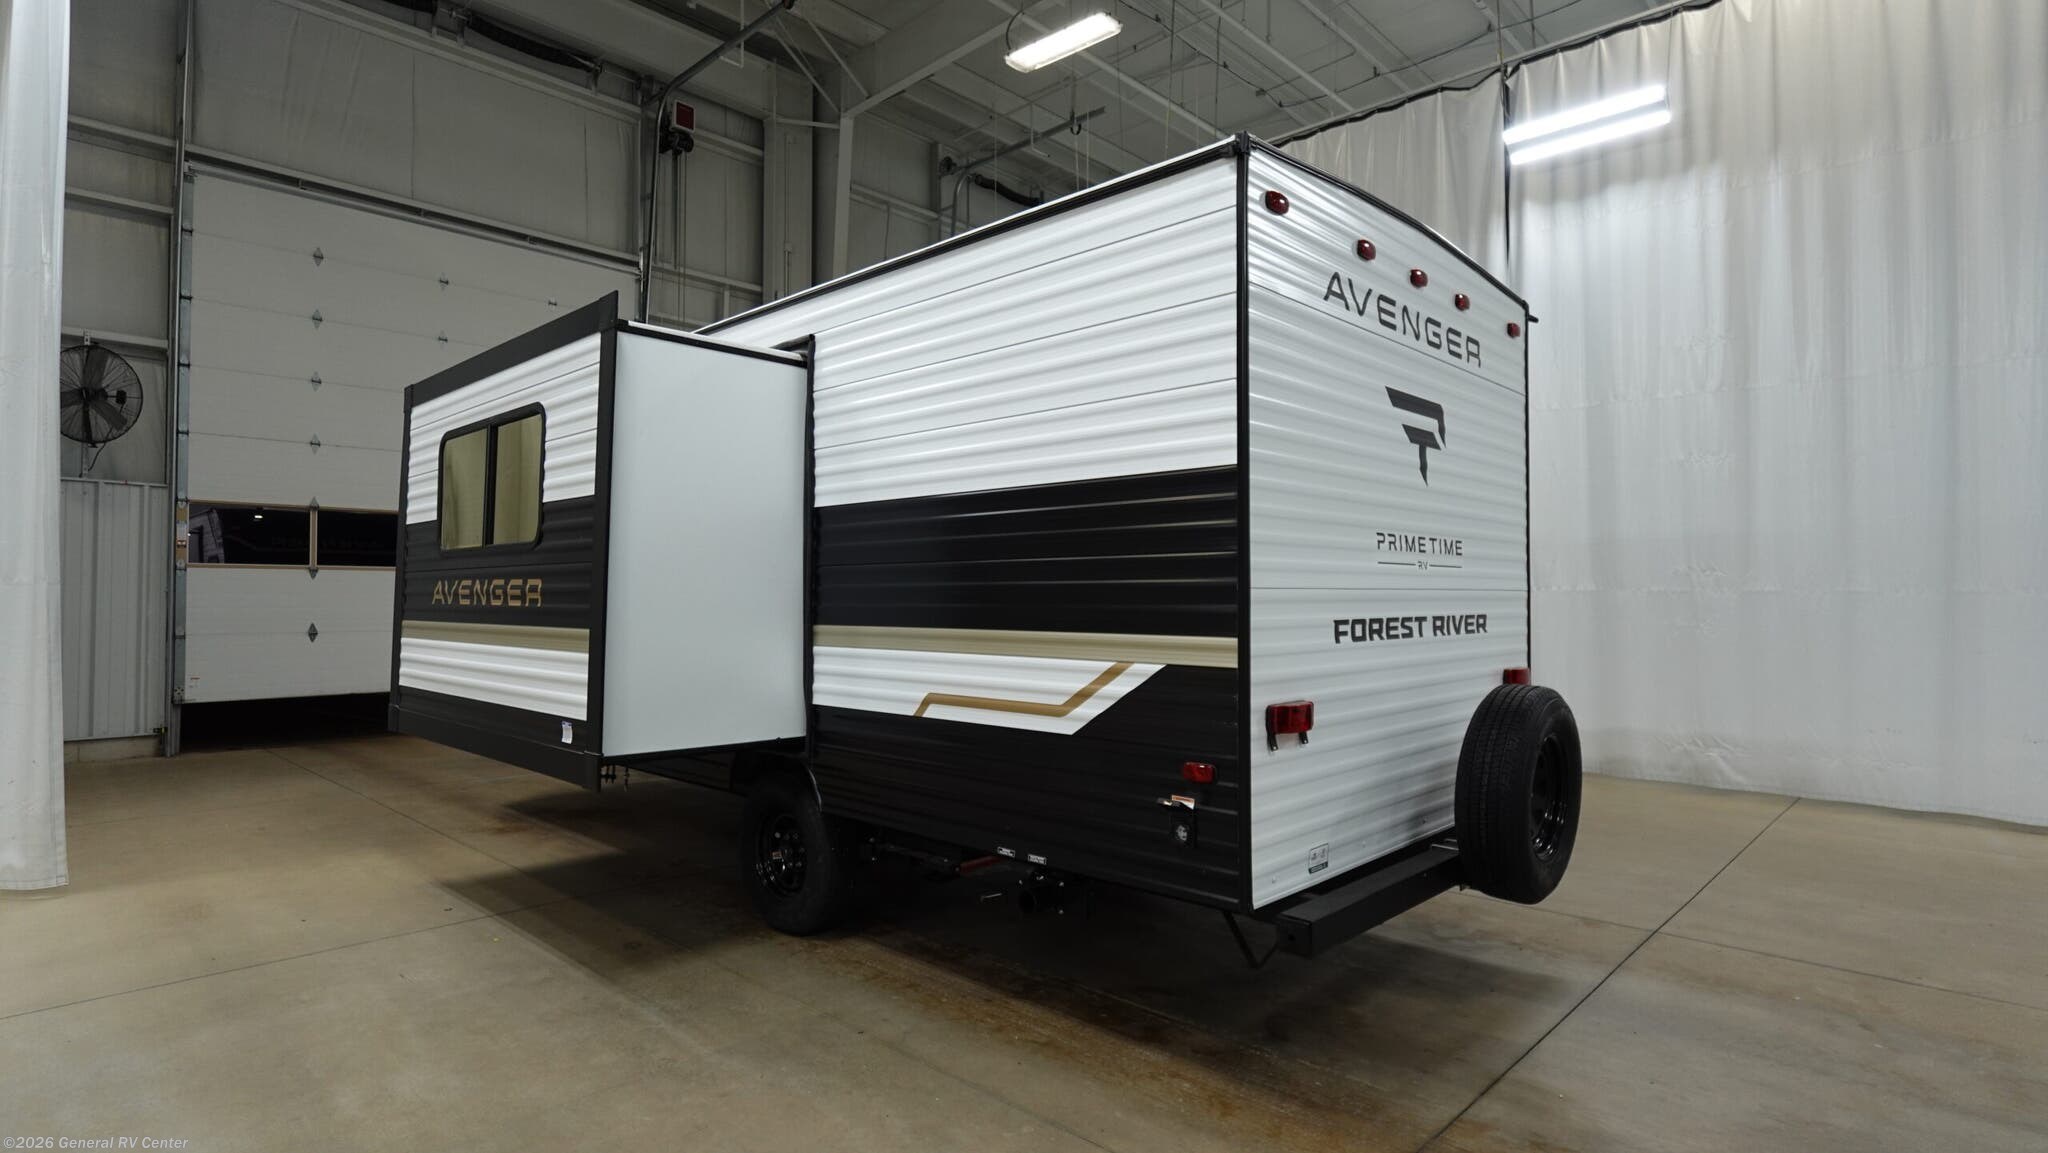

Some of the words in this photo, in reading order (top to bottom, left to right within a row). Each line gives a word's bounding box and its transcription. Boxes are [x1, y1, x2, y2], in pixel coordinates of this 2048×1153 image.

[1323, 271, 1482, 368] AVENGER
[431, 578, 543, 608] AVENGER
[1333, 616, 1428, 644] FOREST
[1432, 614, 1488, 637] RIVER
